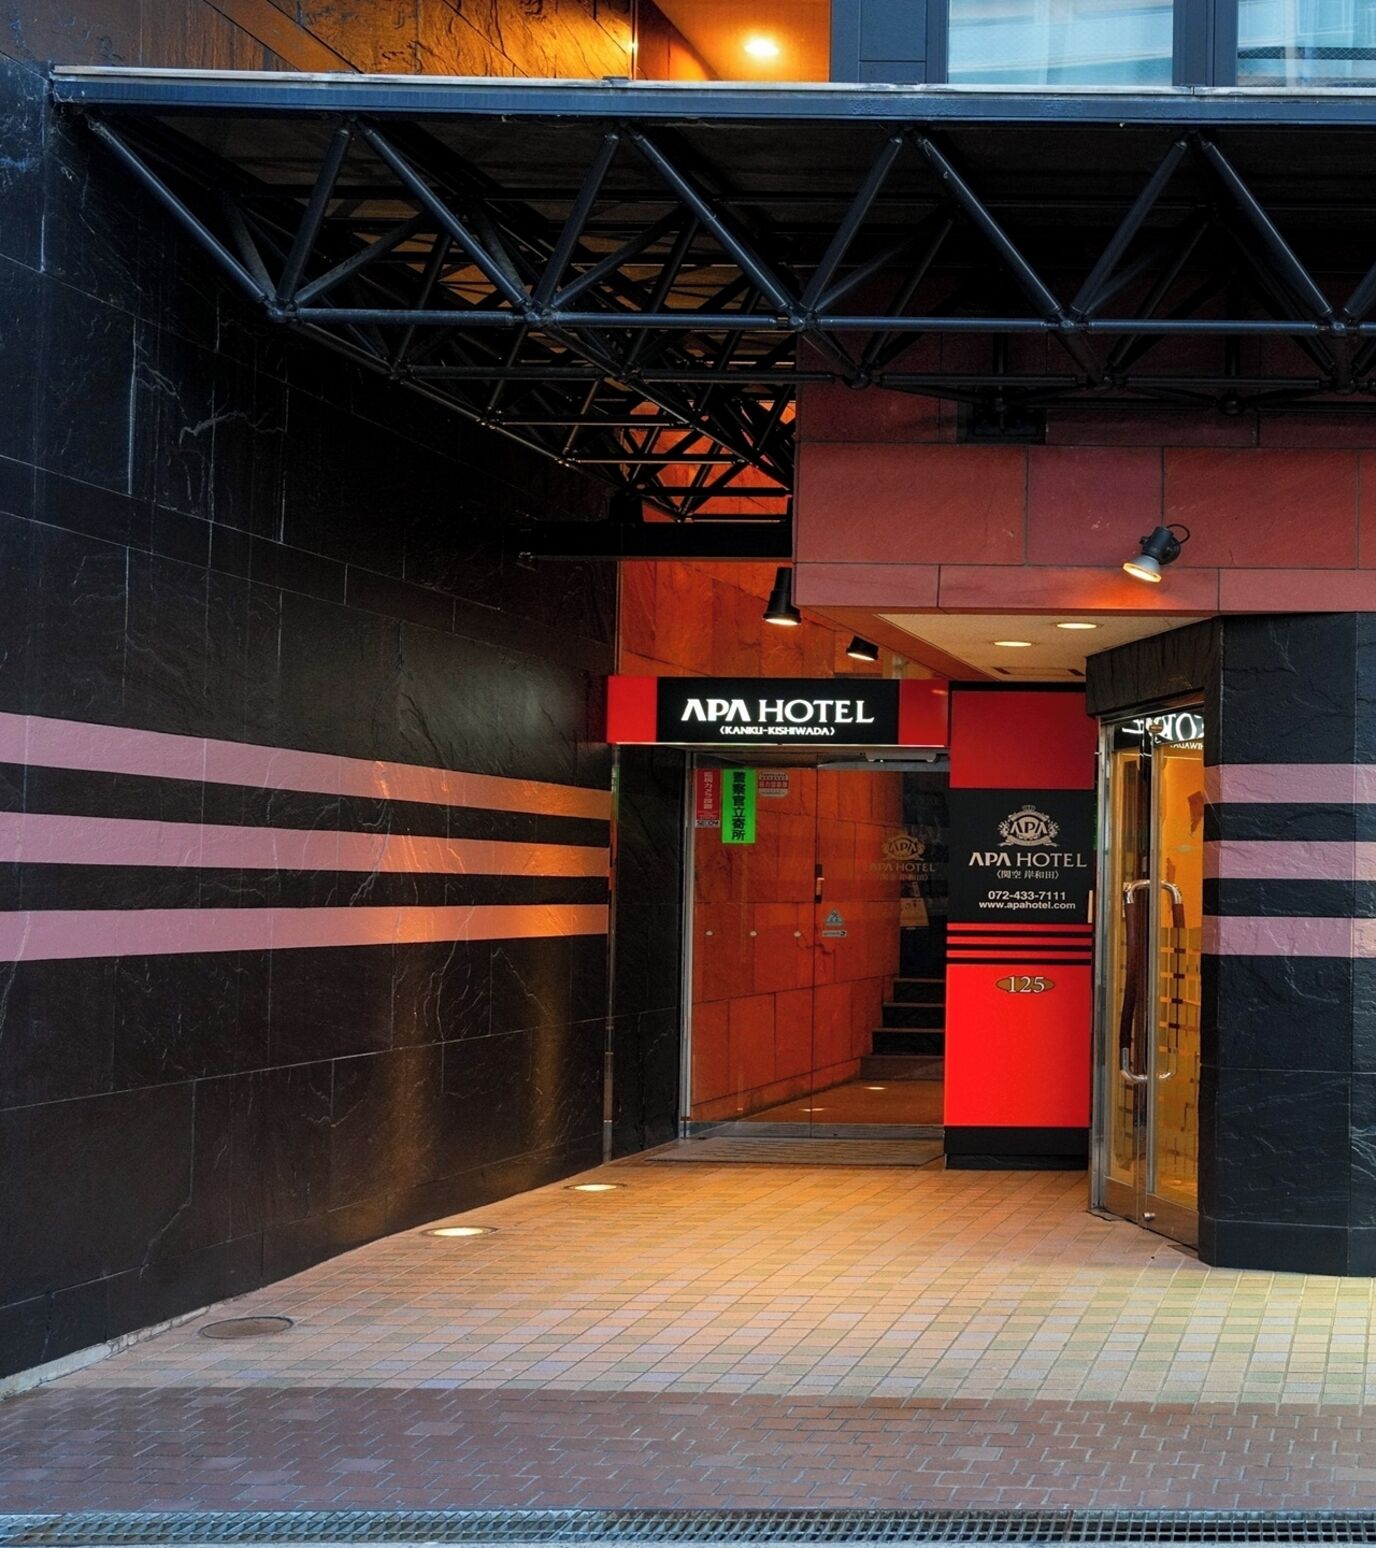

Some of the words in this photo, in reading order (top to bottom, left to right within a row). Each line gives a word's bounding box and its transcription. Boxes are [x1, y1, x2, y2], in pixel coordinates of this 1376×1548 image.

[681, 698, 751, 722] APA
[758, 699, 875, 723] HOTEL
[968, 852, 1012, 867] APA
[1016, 852, 1087, 868] HOTEL
[895, 863, 936, 872] HOTEL
[988, 890, 1066, 900] 072-433-7111
[979, 901, 1076, 911] www.apahotel.com
[1008, 976, 1045, 993] 125
